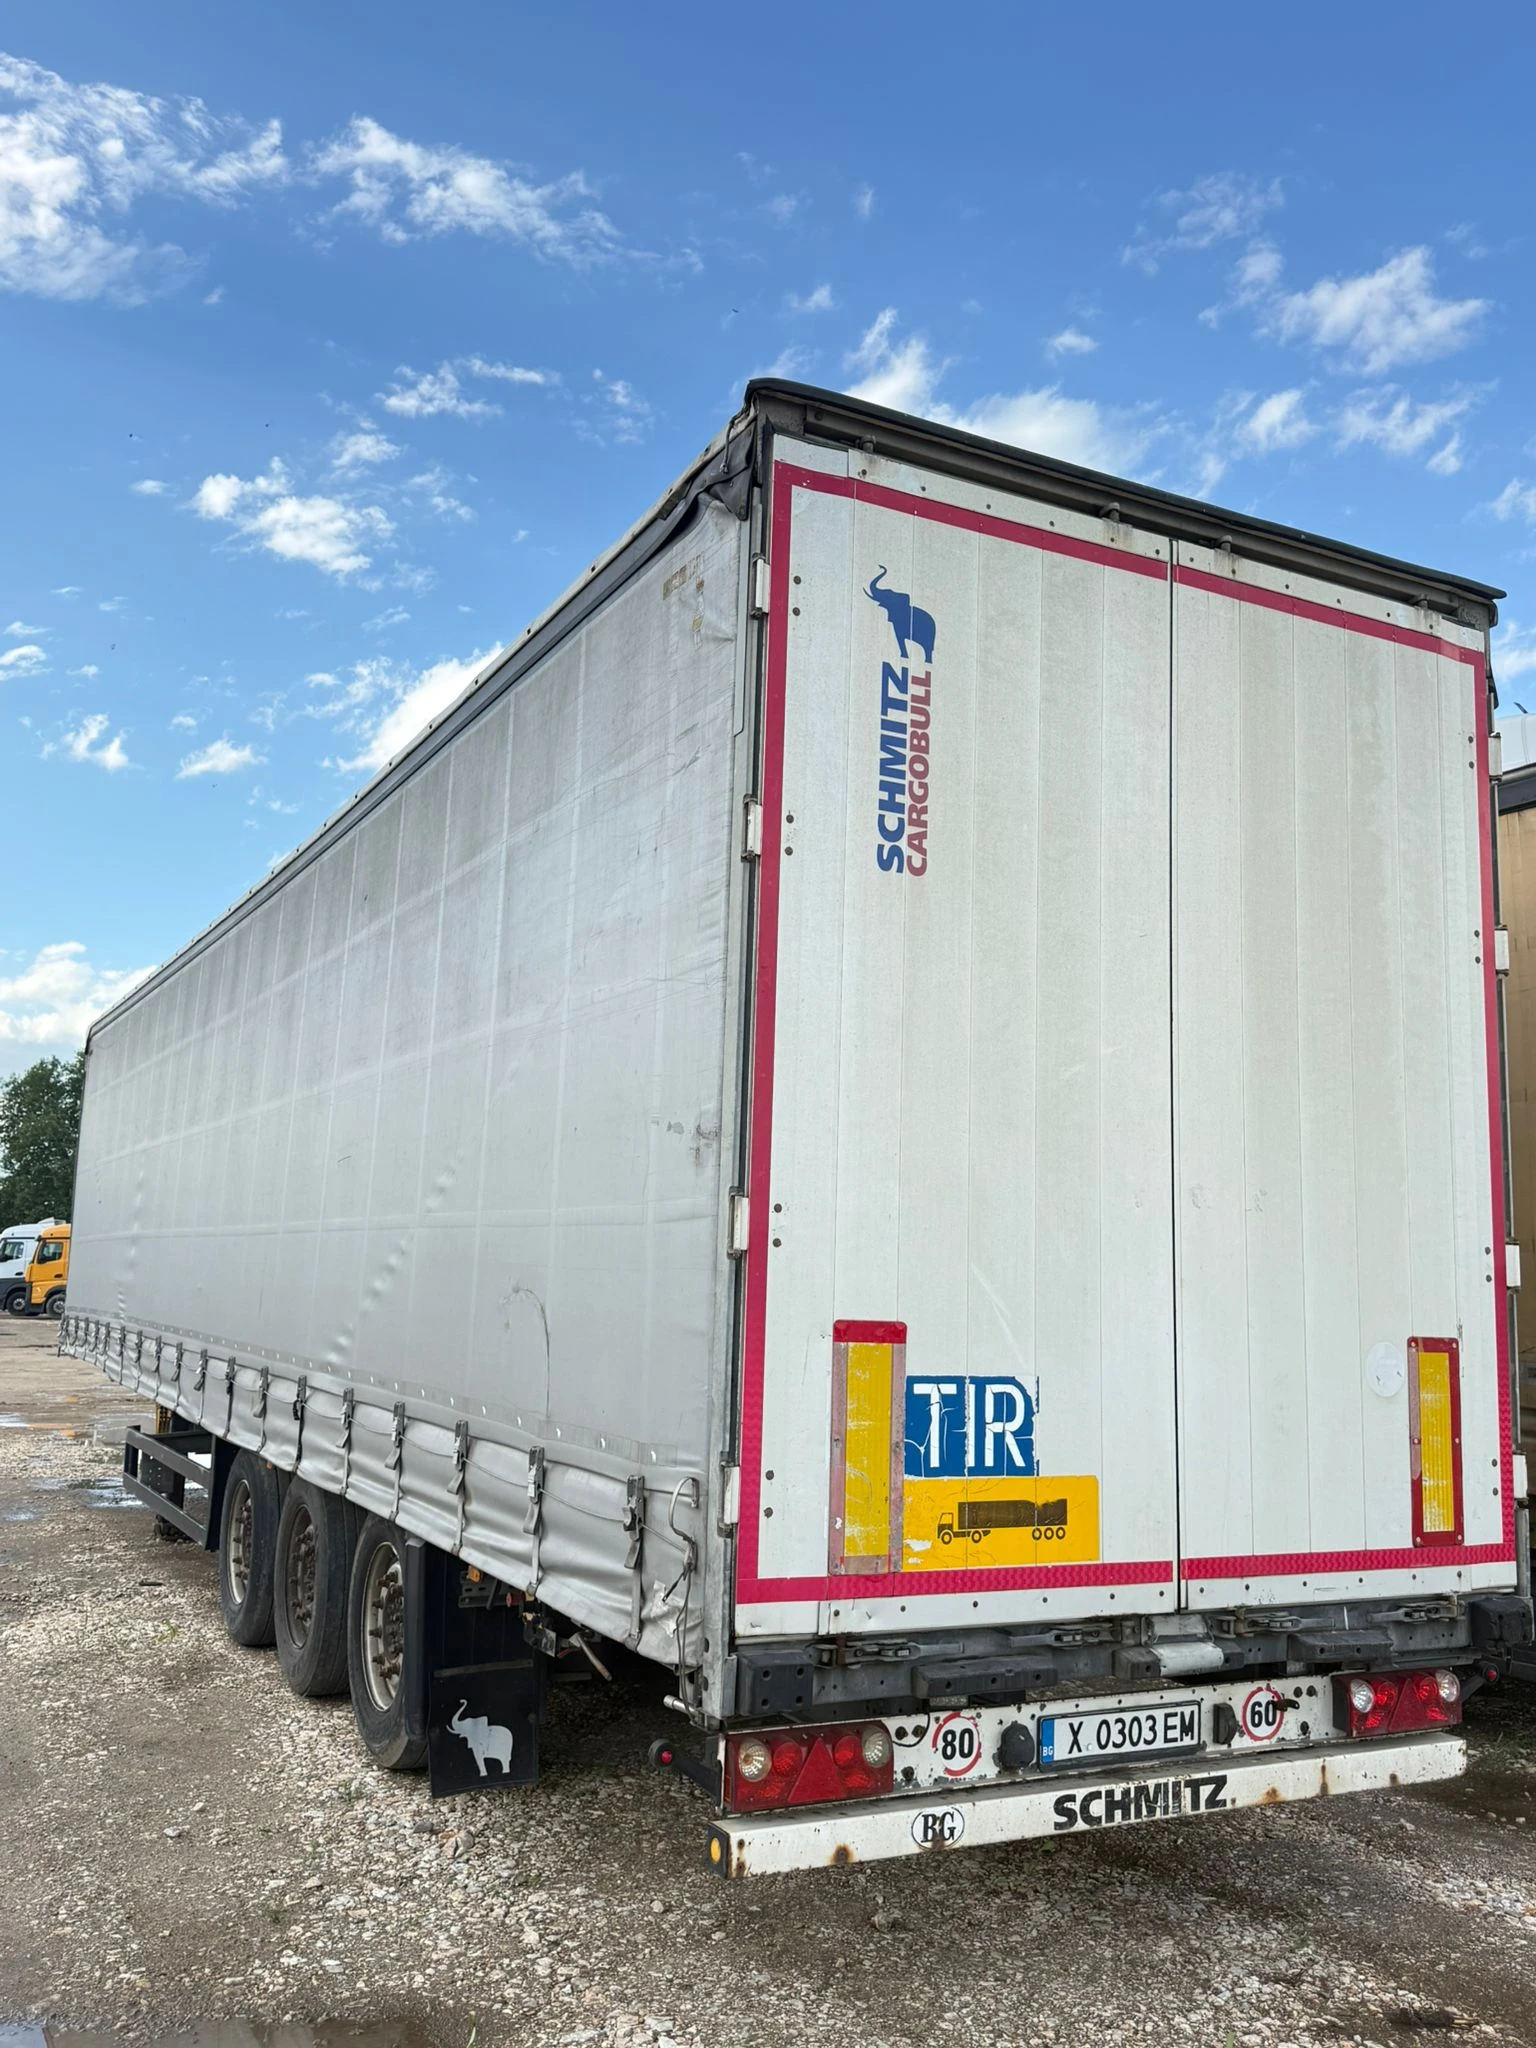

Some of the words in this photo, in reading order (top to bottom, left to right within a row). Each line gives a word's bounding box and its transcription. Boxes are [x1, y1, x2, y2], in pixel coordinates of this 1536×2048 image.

[877, 661, 909, 873] SCHMITZ
[906, 671, 931, 876] CARGOBULL
[913, 1383, 1026, 1468] TIR
[1068, 1721, 1084, 1754] X
[1096, 1714, 1158, 1750] 0303
[1163, 1710, 1195, 1744] EM
[1250, 1700, 1277, 1728] 60
[942, 1728, 974, 1760] 80
[1042, 1745, 1054, 1756] BG
[1053, 1774, 1228, 1831] SCHMITZ
[921, 1811, 956, 1843] BG
